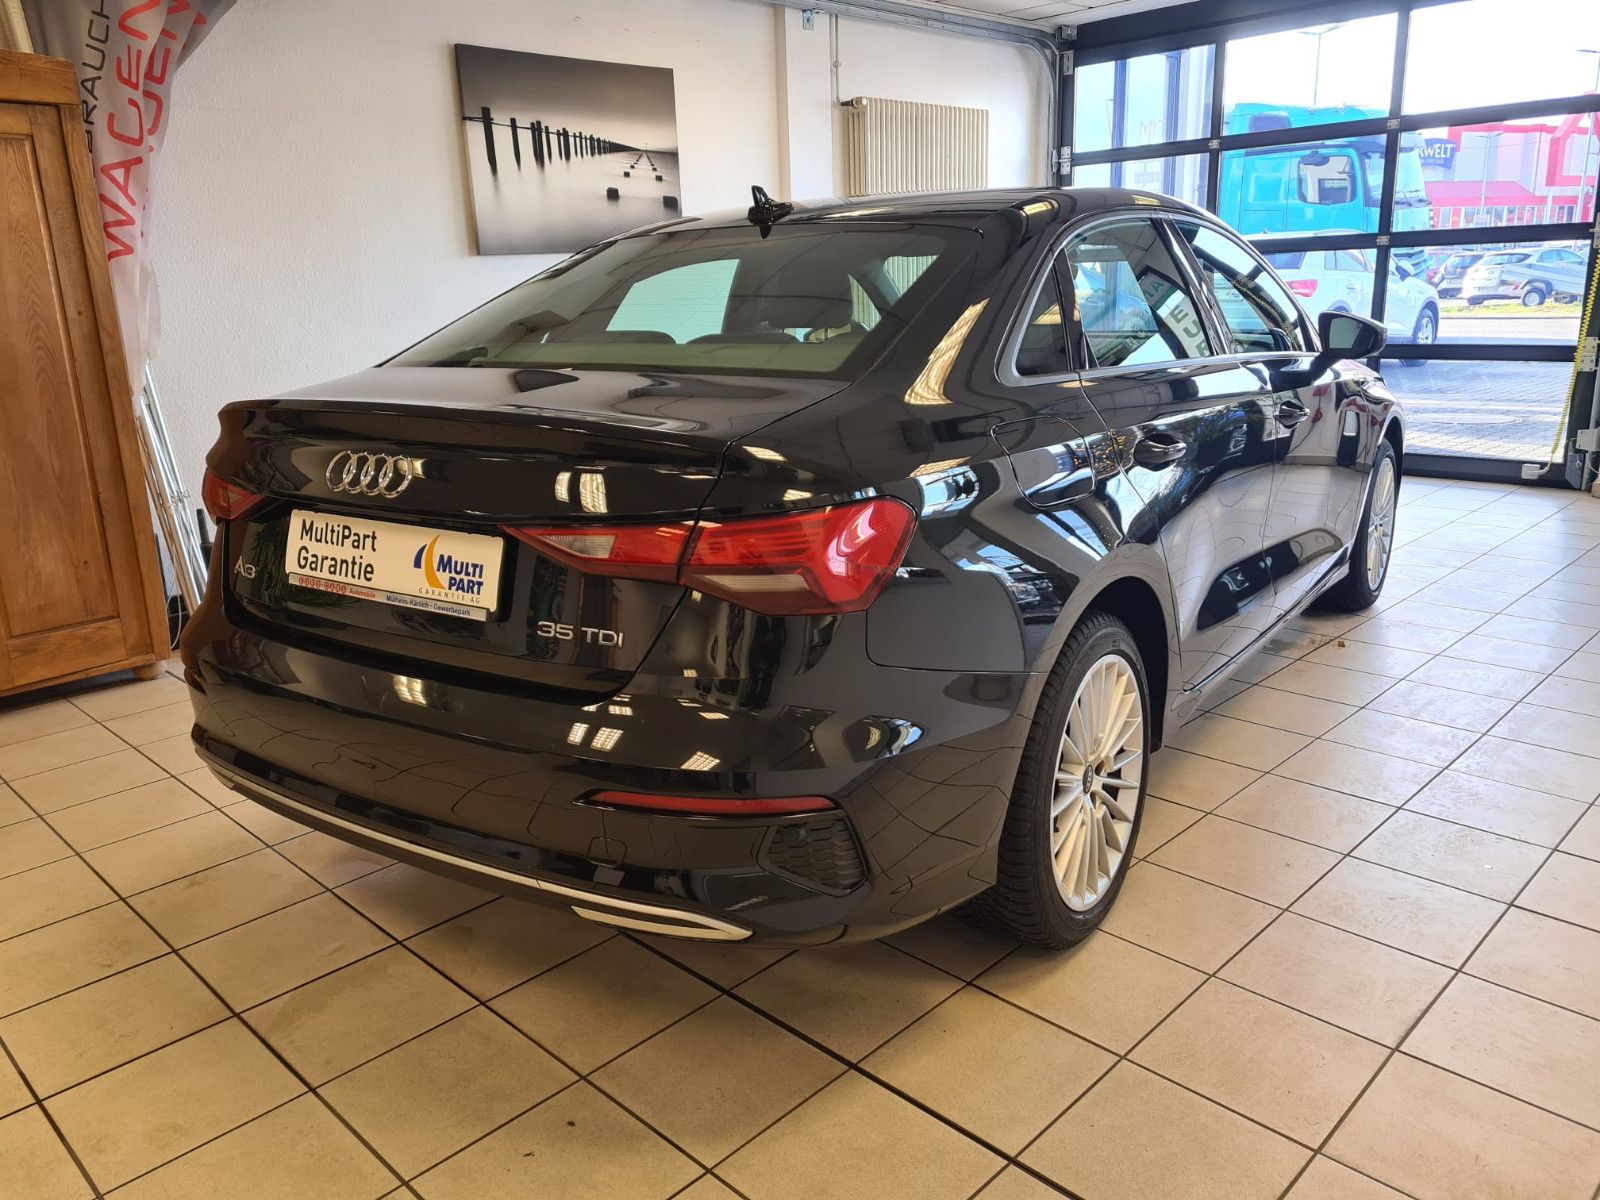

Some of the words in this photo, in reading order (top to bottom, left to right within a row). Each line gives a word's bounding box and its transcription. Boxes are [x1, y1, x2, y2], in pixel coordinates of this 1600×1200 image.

[300, 518, 377, 552] MultiPart
[234, 555, 256, 579] A3
[297, 545, 374, 582] Garantie
[436, 554, 484, 579] MULTI
[418, 587, 466, 602] GARANTIE
[470, 596, 481, 604] AG
[448, 576, 484, 596] PART
[433, 603, 471, 617] Gewerbepark
[537, 621, 574, 640] 35
[581, 627, 624, 648] TDI
